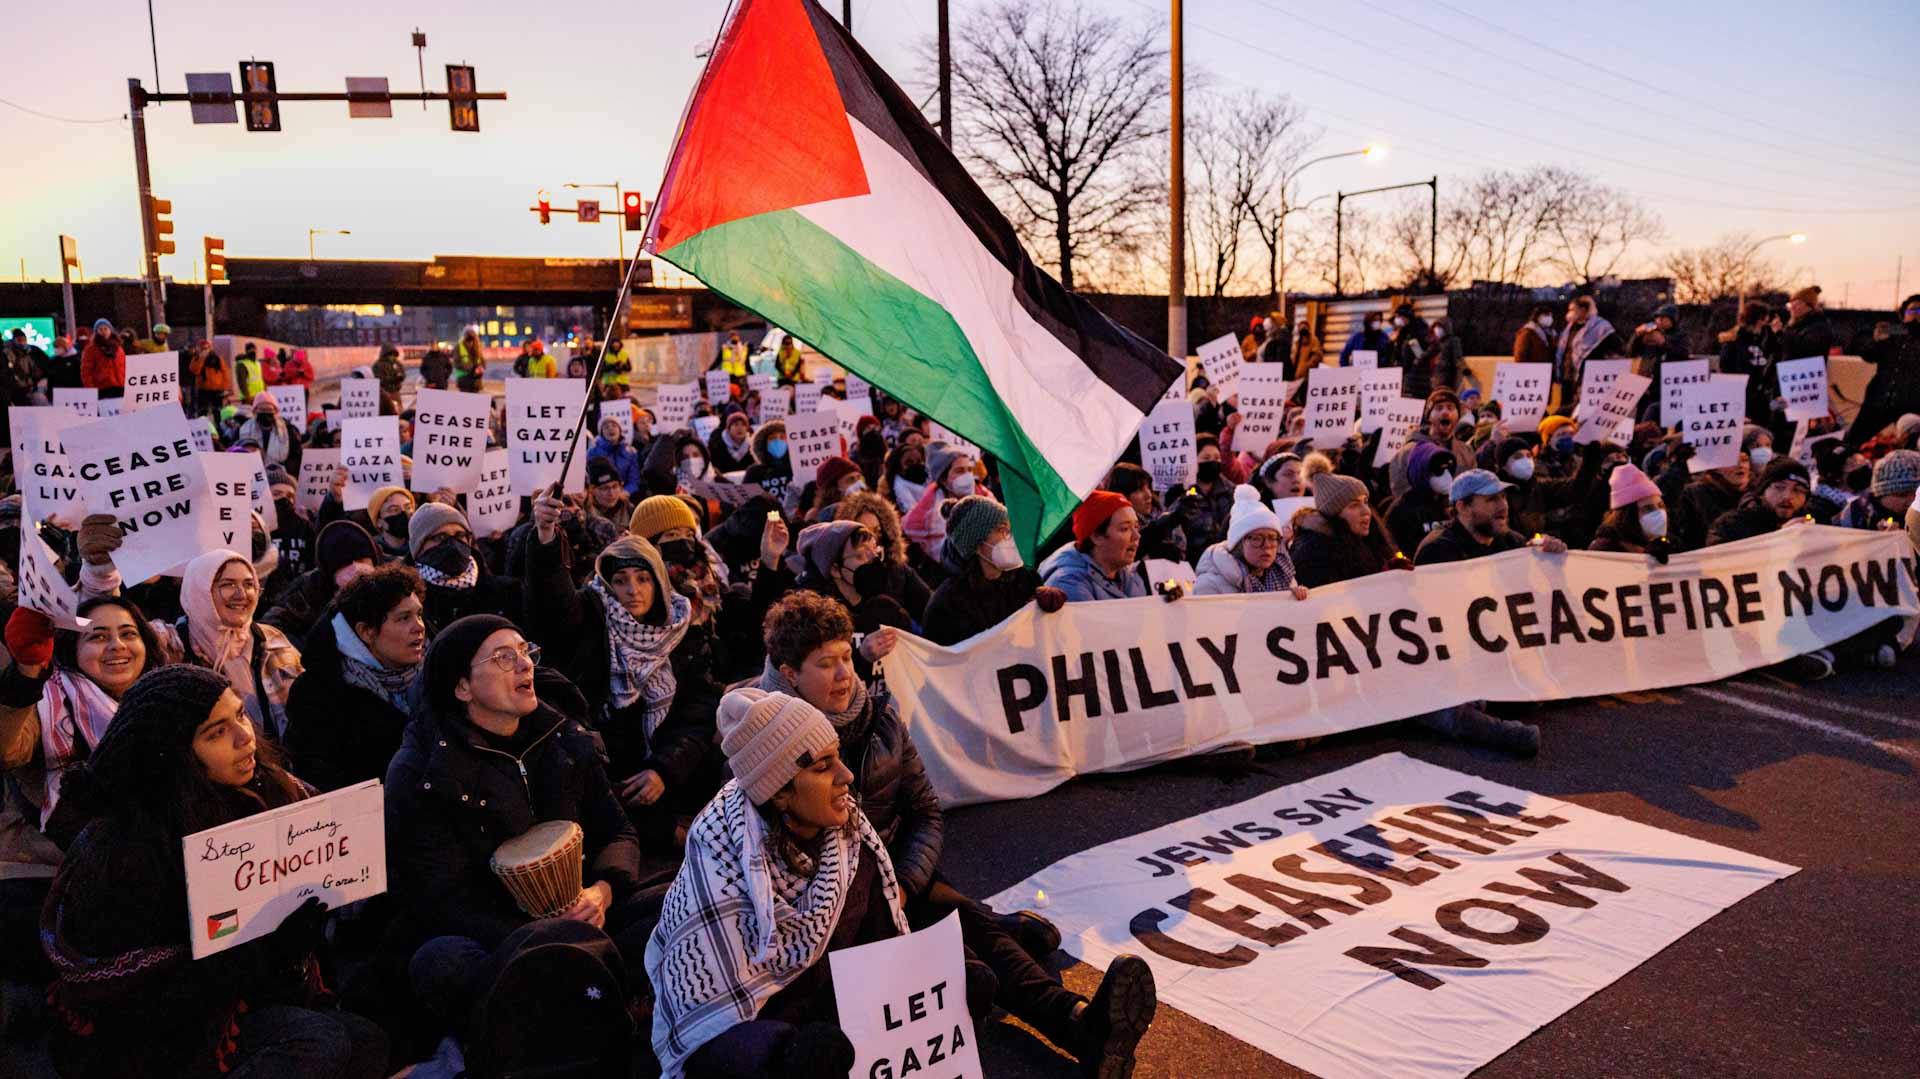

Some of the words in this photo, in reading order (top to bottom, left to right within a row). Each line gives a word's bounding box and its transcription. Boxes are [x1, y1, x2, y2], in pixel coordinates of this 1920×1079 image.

[1204, 347, 1239, 366] CEASE
[1214, 360, 1238, 374] FIRE
[128, 372, 176, 386] CEASE
[1218, 371, 1240, 386] NOW
[1664, 375, 1706, 385] CEASE
[1782, 370, 1824, 383] CEASE
[1516, 380, 1539, 388] LET
[1790, 383, 1818, 392] FIRE
[136, 390, 170, 403] FIRE
[1310, 386, 1356, 397] CEASE
[1616, 390, 1634, 401] LET
[1242, 398, 1282, 406] CEASE
[1791, 394, 1820, 403] NOW
[527, 406, 566, 418] LET
[1316, 402, 1348, 412] FIRE
[1699, 402, 1730, 414] LET
[420, 413, 485, 428] CEASE
[1314, 418, 1347, 428] NOW
[1691, 418, 1737, 431] GAZA
[517, 428, 576, 441] GAZA
[789, 426, 837, 440] CEASE
[1153, 423, 1180, 434] LET
[355, 438, 384, 448] LET
[429, 434, 473, 447] FIRE
[1147, 438, 1189, 451] GAZA
[1695, 436, 1732, 447] LIVE
[799, 442, 831, 453] FIRE
[80, 439, 191, 481] CEASE
[347, 456, 393, 466] GAZA
[426, 454, 472, 467] NOW
[34, 464, 75, 477] GA
[481, 469, 507, 482] LET
[352, 473, 392, 483] LIVE
[762, 476, 787, 488] NOT
[40, 486, 84, 500] LIV
[110, 474, 184, 508] FIRE
[479, 500, 512, 515] LIVE
[117, 499, 191, 536] NOW
[740, 558, 760, 573] NO
[996, 634, 1240, 734] PHILLY
[1266, 608, 1450, 685] SAYS:
[1467, 572, 1764, 654] CEASEFIRE
[1136, 821, 1282, 878] JEWS
[1274, 787, 1376, 826] SAY
[200, 837, 255, 862] Stop
[288, 820, 342, 845] funding
[235, 836, 349, 892] GENOCIDE
[1129, 791, 1569, 970] CEASEFIRE
[1342, 852, 1631, 990] NOW
[883, 981, 946, 1031] LET
[870, 1024, 965, 1079] GAZA
